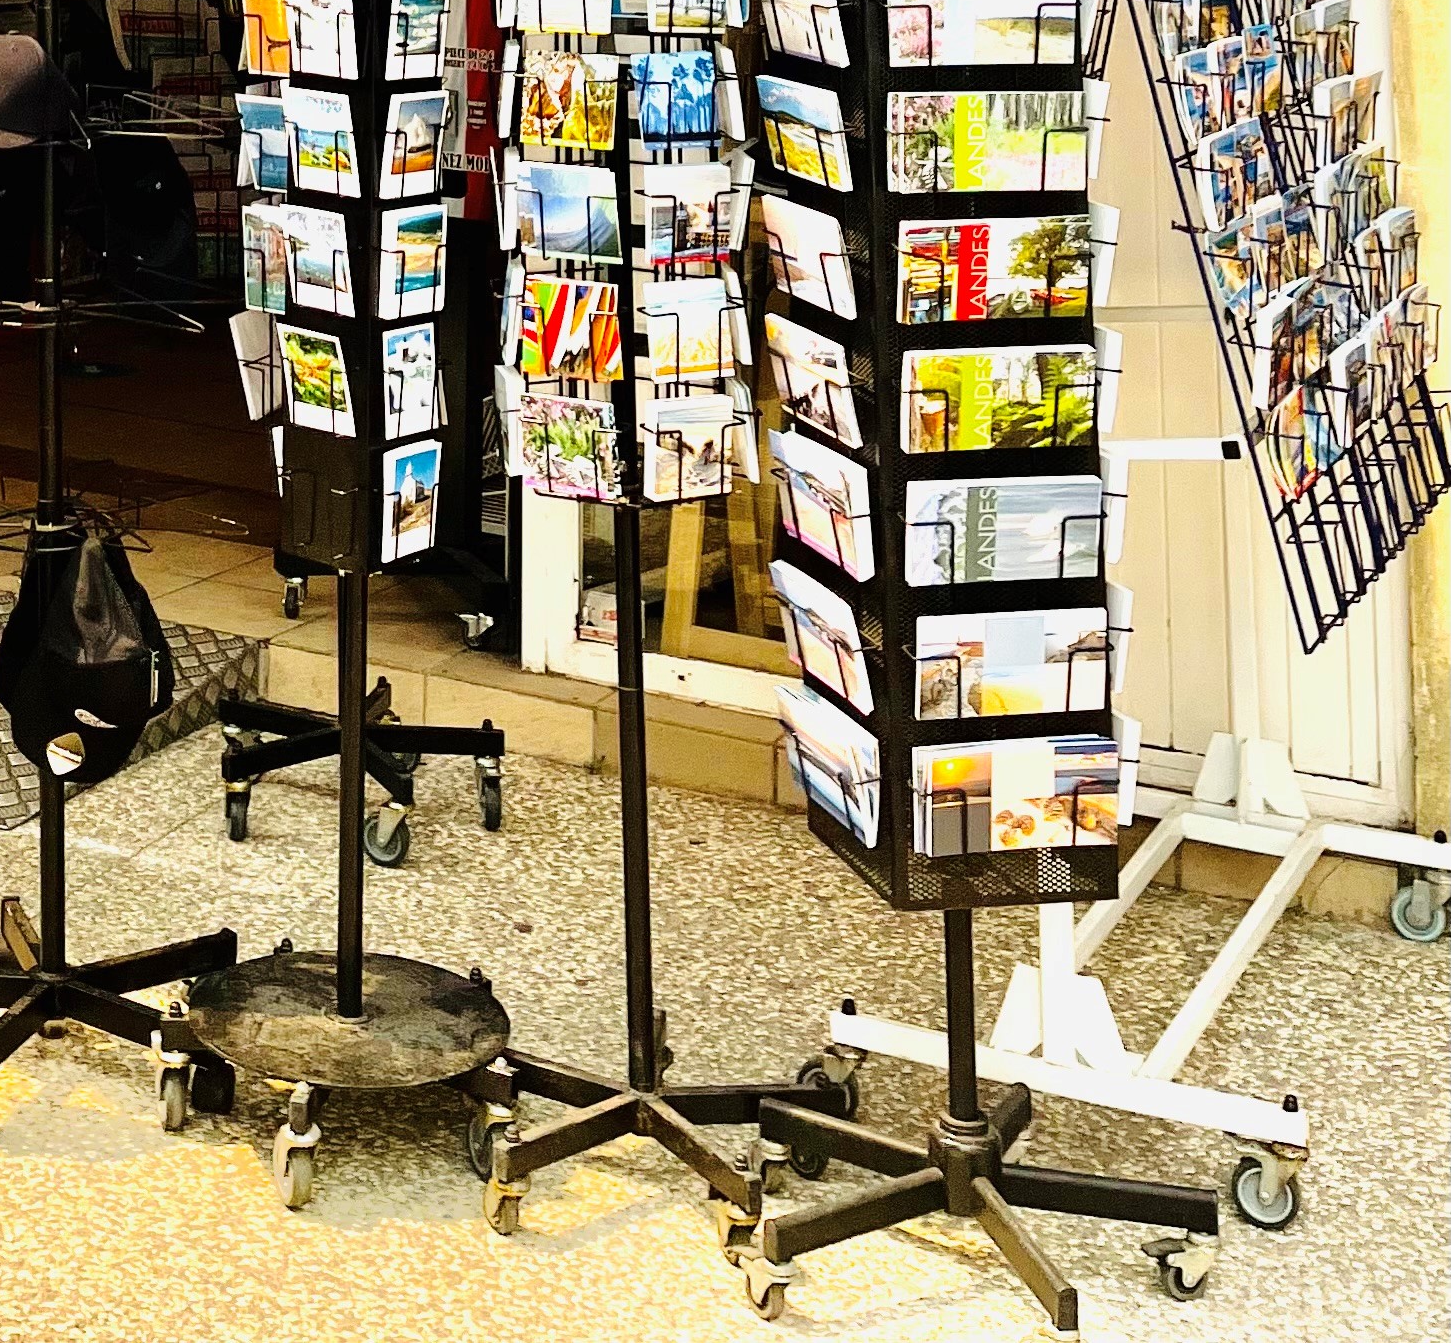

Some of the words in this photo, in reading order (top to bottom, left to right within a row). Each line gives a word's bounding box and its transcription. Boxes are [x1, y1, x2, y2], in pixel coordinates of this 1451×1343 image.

[967, 96, 987, 191] LANDES
[968, 225, 991, 321] LANDES
[973, 354, 994, 448] LANDES
[977, 486, 999, 582] LANDES
